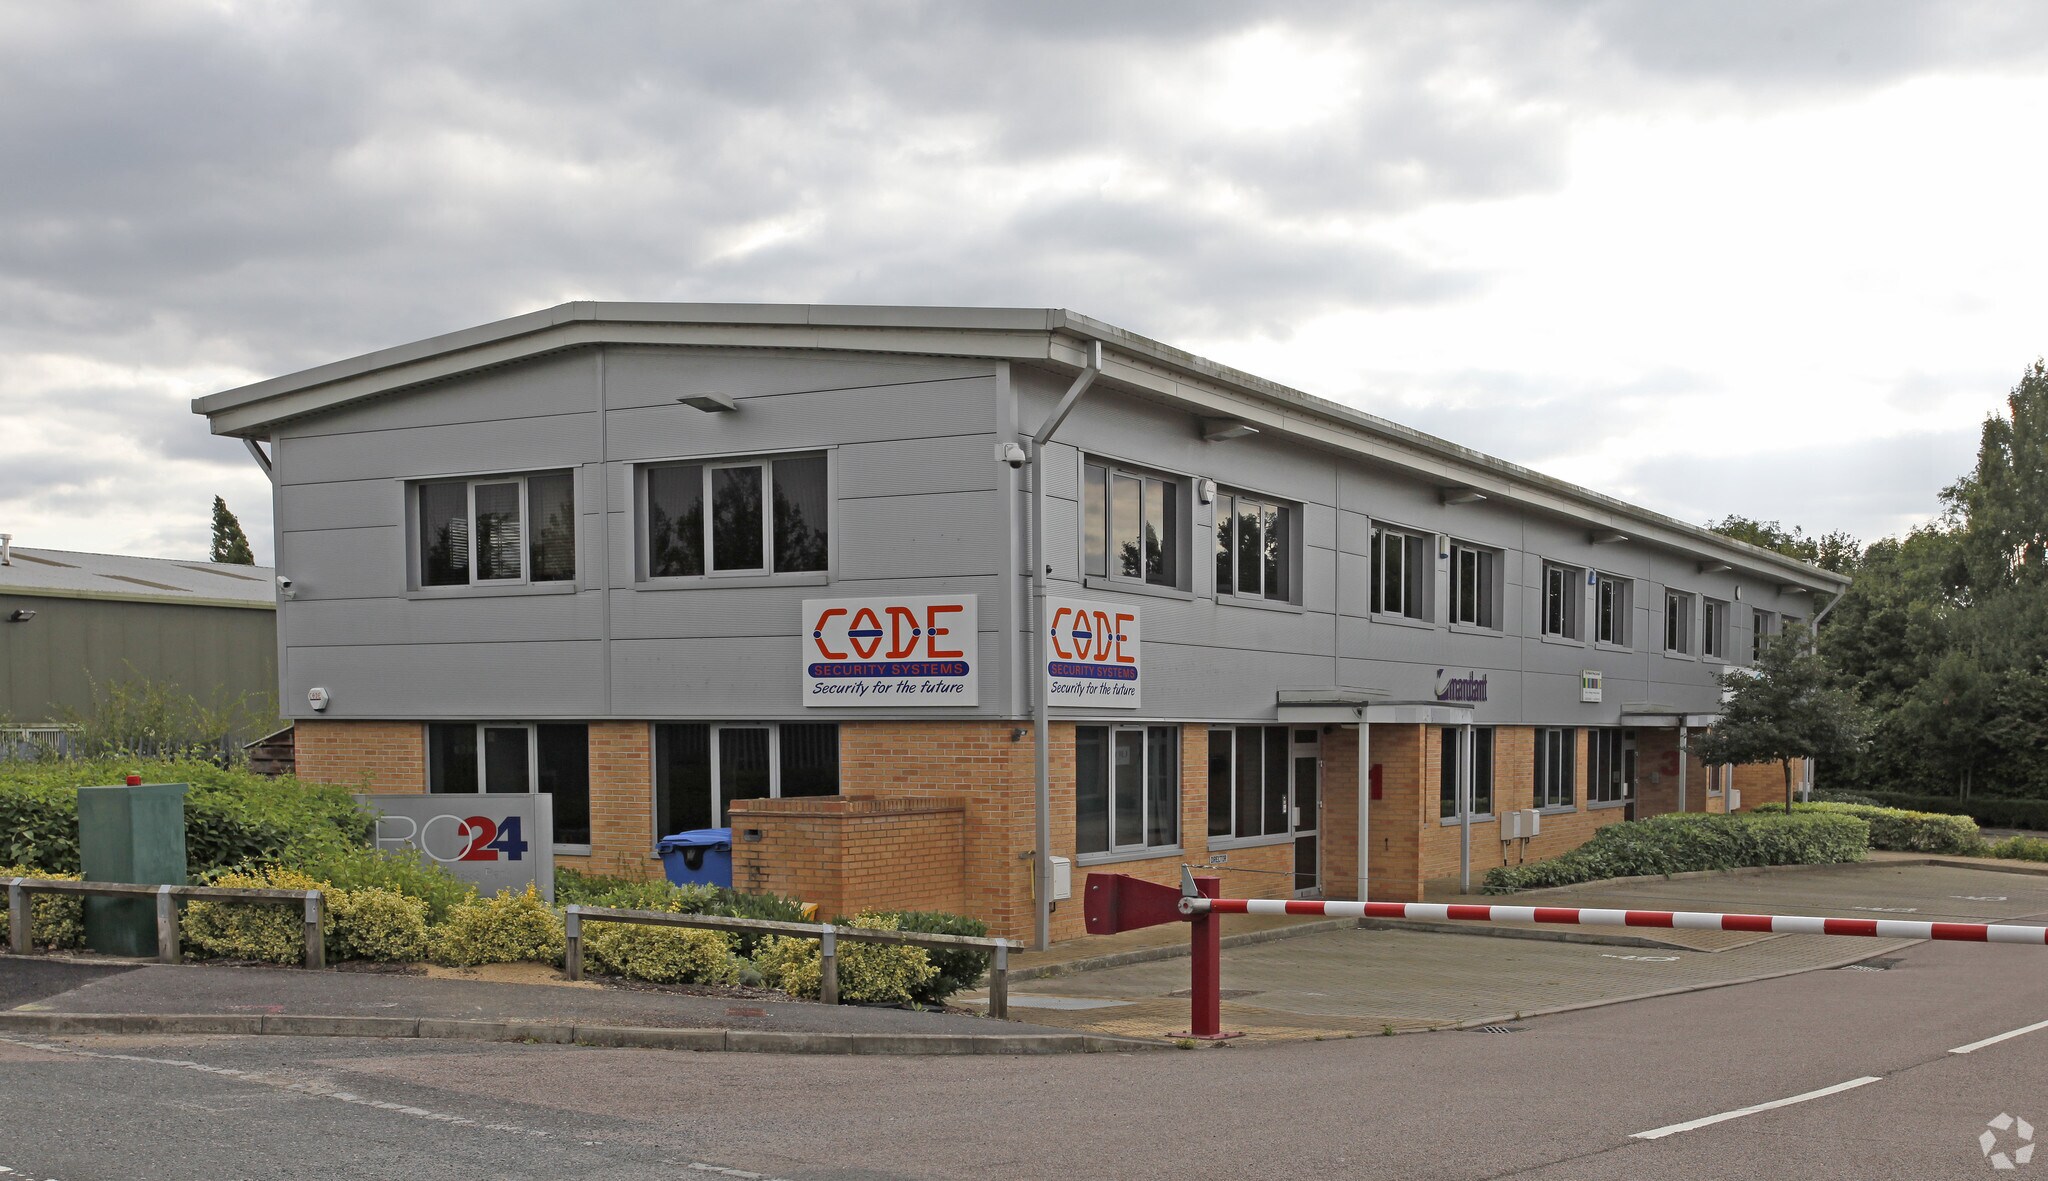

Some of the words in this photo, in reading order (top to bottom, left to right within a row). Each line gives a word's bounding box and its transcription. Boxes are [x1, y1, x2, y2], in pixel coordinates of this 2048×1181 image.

[813, 605, 963, 660] CODE
[1050, 607, 1135, 664] CODE
[814, 665, 886, 676] SECURITY
[891, 663, 963, 675] SYSTEMS
[1051, 663, 1095, 677] SECURITY
[1097, 666, 1135, 679] SYSTEMS
[812, 680, 869, 697] Security
[872, 681, 893, 694] for
[896, 680, 917, 694] the
[920, 680, 964, 694] future
[1050, 681, 1085, 697] Security
[1085, 682, 1098, 695] for
[1099, 682, 1111, 695] the
[1112, 683, 1136, 696] future
